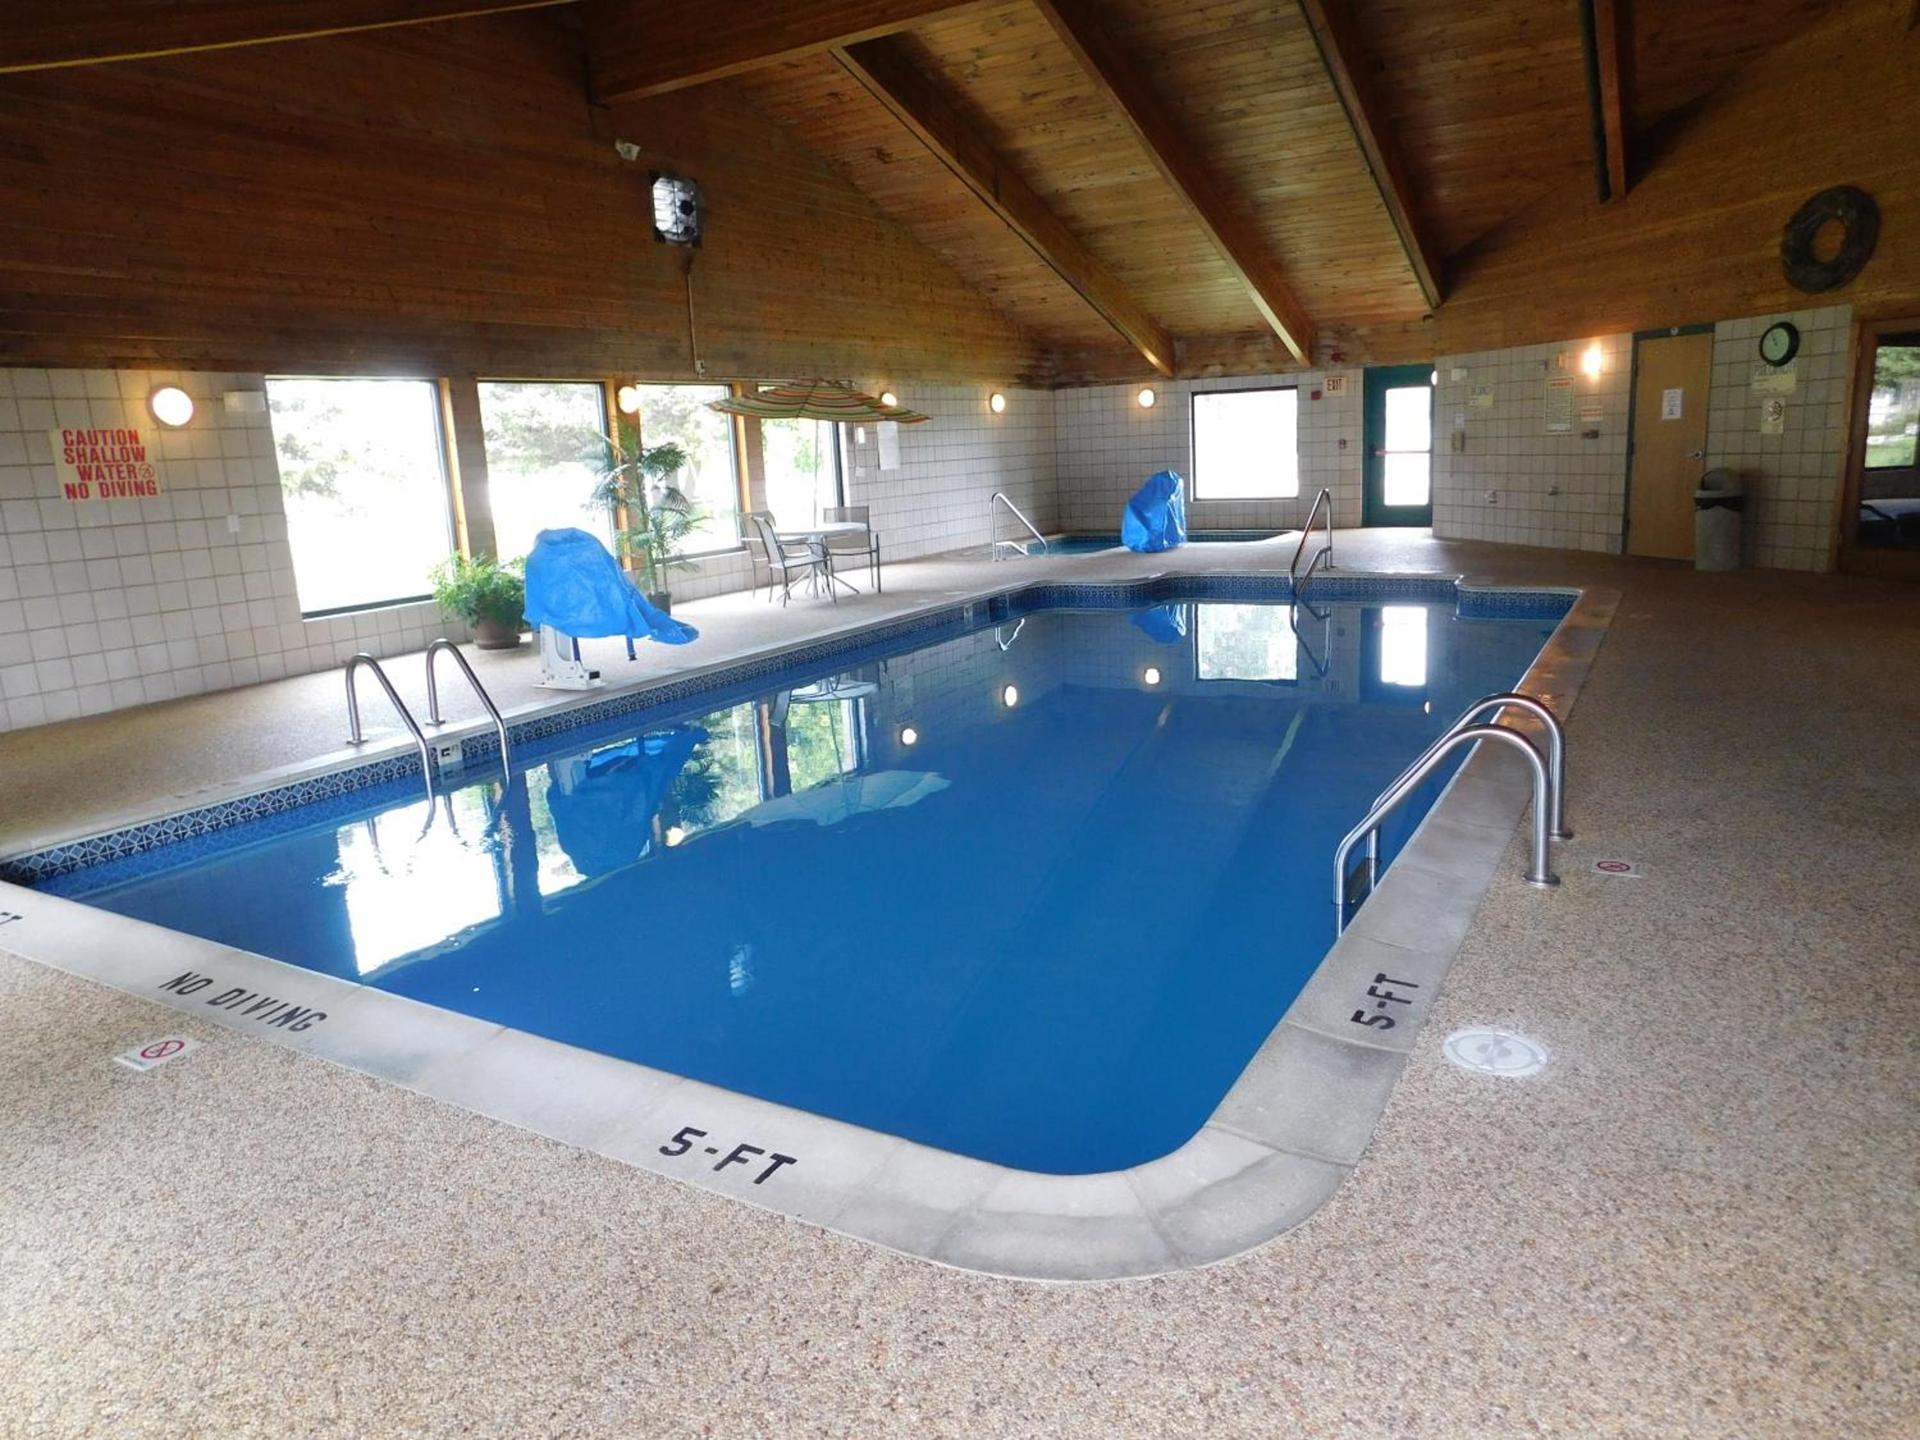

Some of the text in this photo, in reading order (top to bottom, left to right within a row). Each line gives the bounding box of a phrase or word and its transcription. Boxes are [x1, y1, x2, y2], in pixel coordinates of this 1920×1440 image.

[1327, 378, 1342, 391] EXIT
[62, 429, 140, 446] CAUTION
[64, 446, 146, 464] SHALLOW
[76, 464, 138, 482] WATER
[64, 480, 158, 500] NO DIVING
[158, 971, 327, 1032] NO DIVING
[659, 1127, 798, 1185] 5-FT
